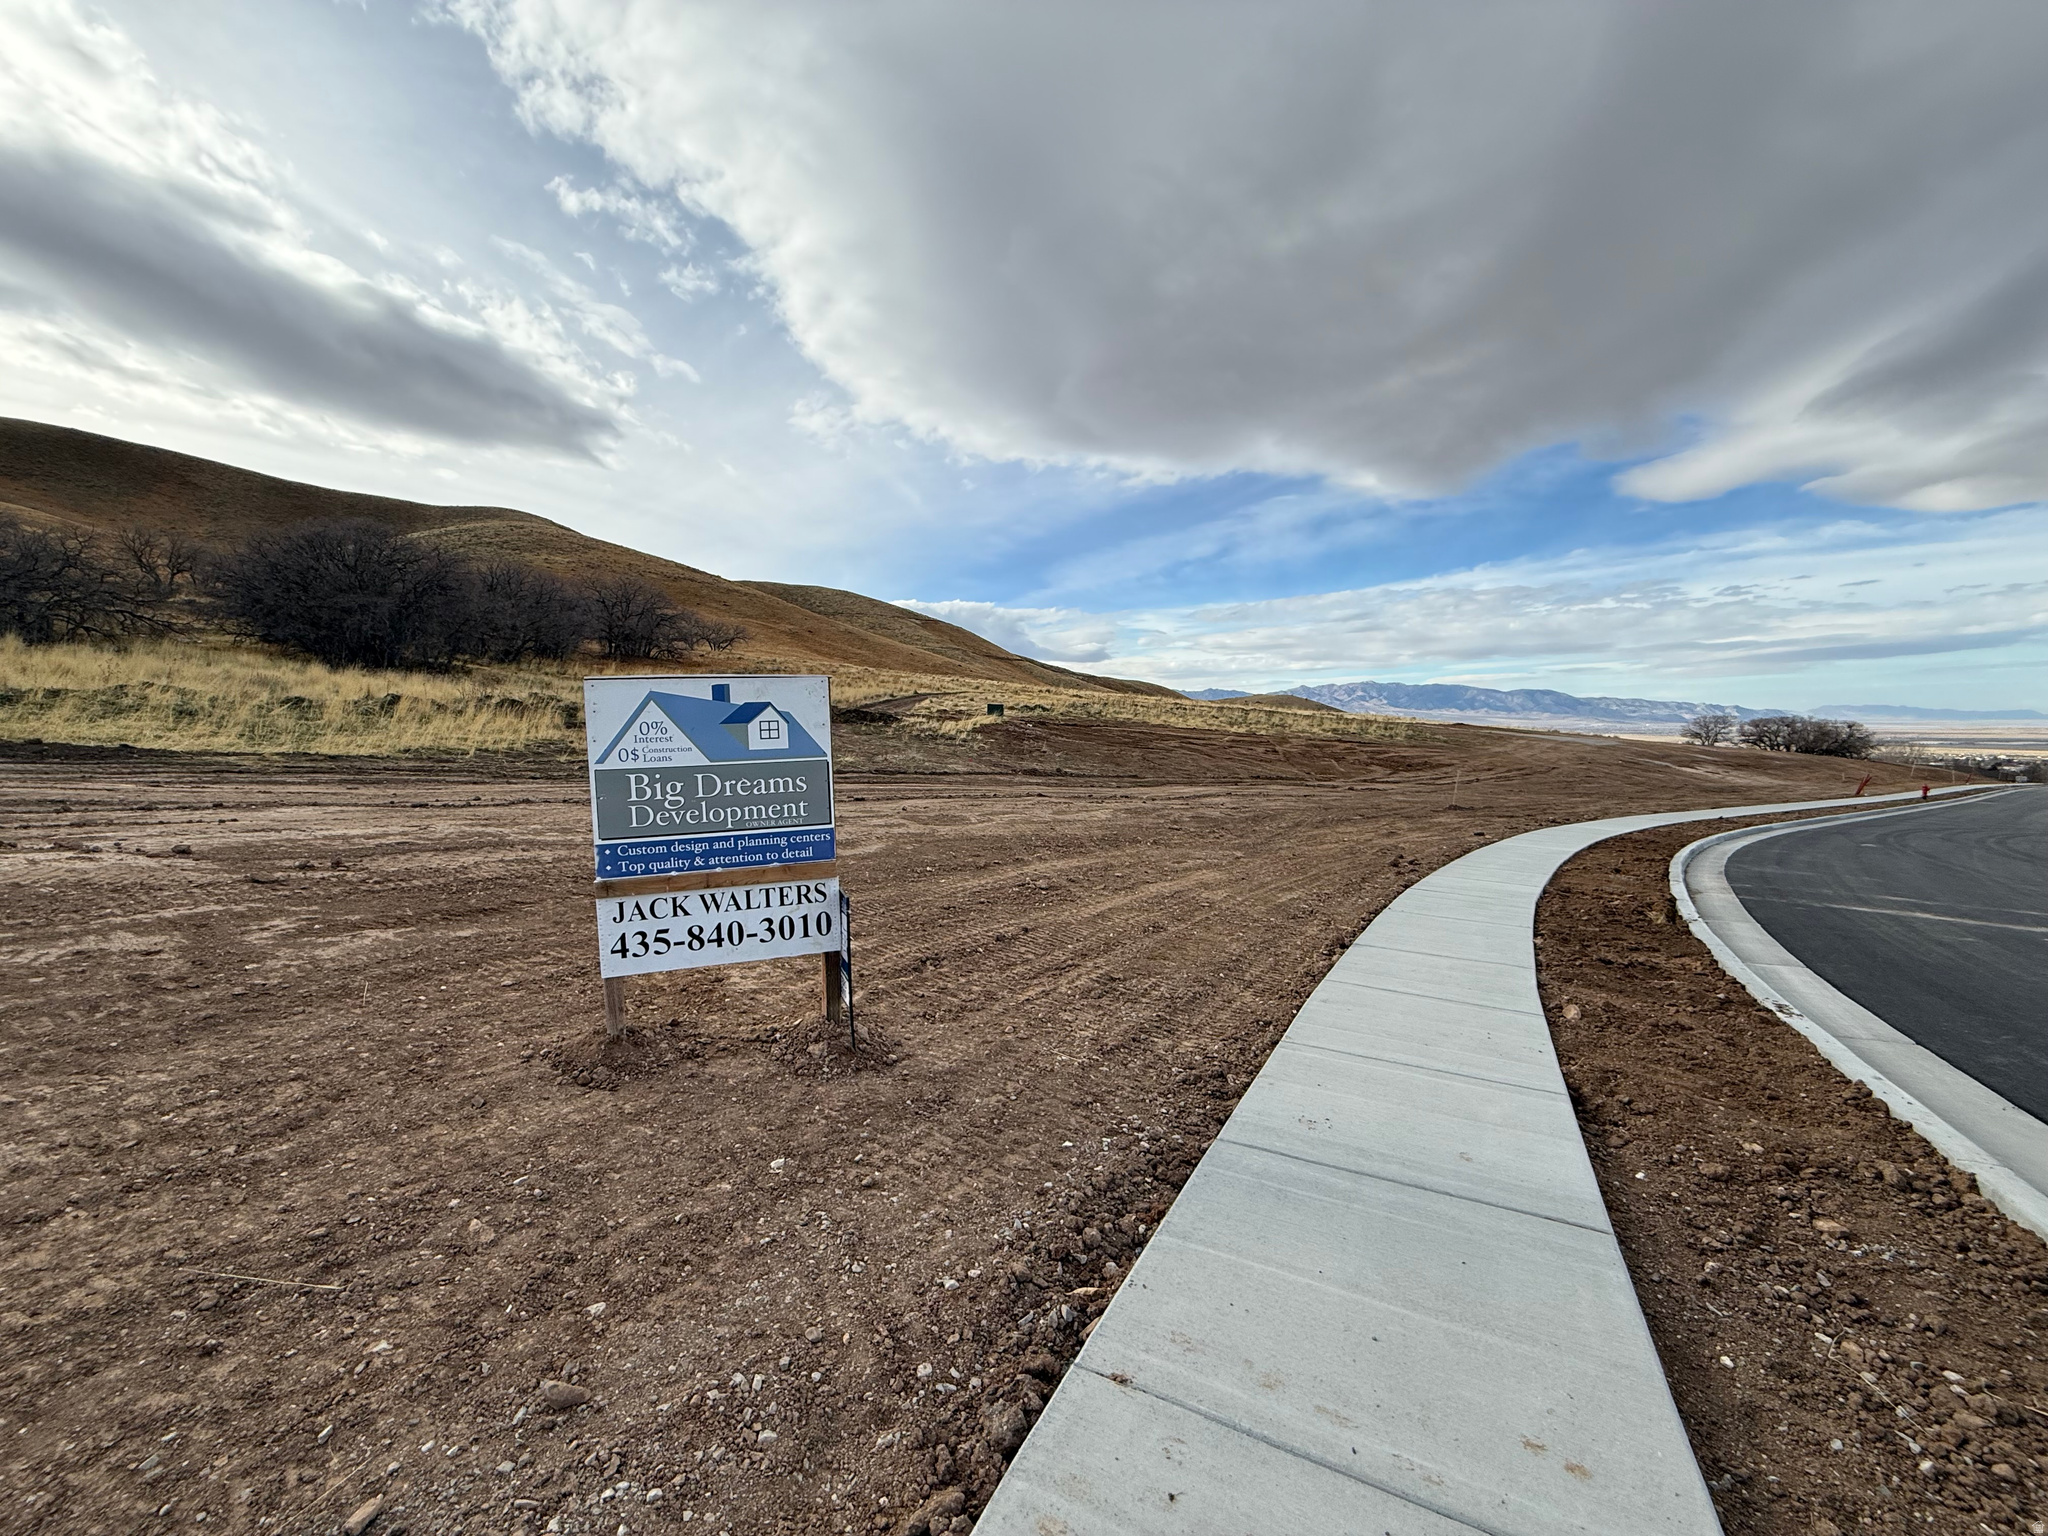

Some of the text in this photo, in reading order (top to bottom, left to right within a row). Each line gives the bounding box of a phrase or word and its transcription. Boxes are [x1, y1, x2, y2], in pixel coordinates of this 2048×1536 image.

[633, 734, 674, 744] Interest
[639, 720, 668, 736] 0%
[618, 745, 693, 763] 0$ Construction
[643, 753, 673, 763] Loans
[625, 773, 808, 810] Big Dreams
[628, 800, 809, 829] Development
[745, 817, 804, 828] OWNER AGENT
[617, 832, 831, 857] Custom design and planning centers
[618, 846, 813, 874] Top quality & attention to detail
[612, 895, 692, 924] JACK
[698, 882, 828, 914] WALTERS
[610, 910, 832, 959] 435-840-3010
